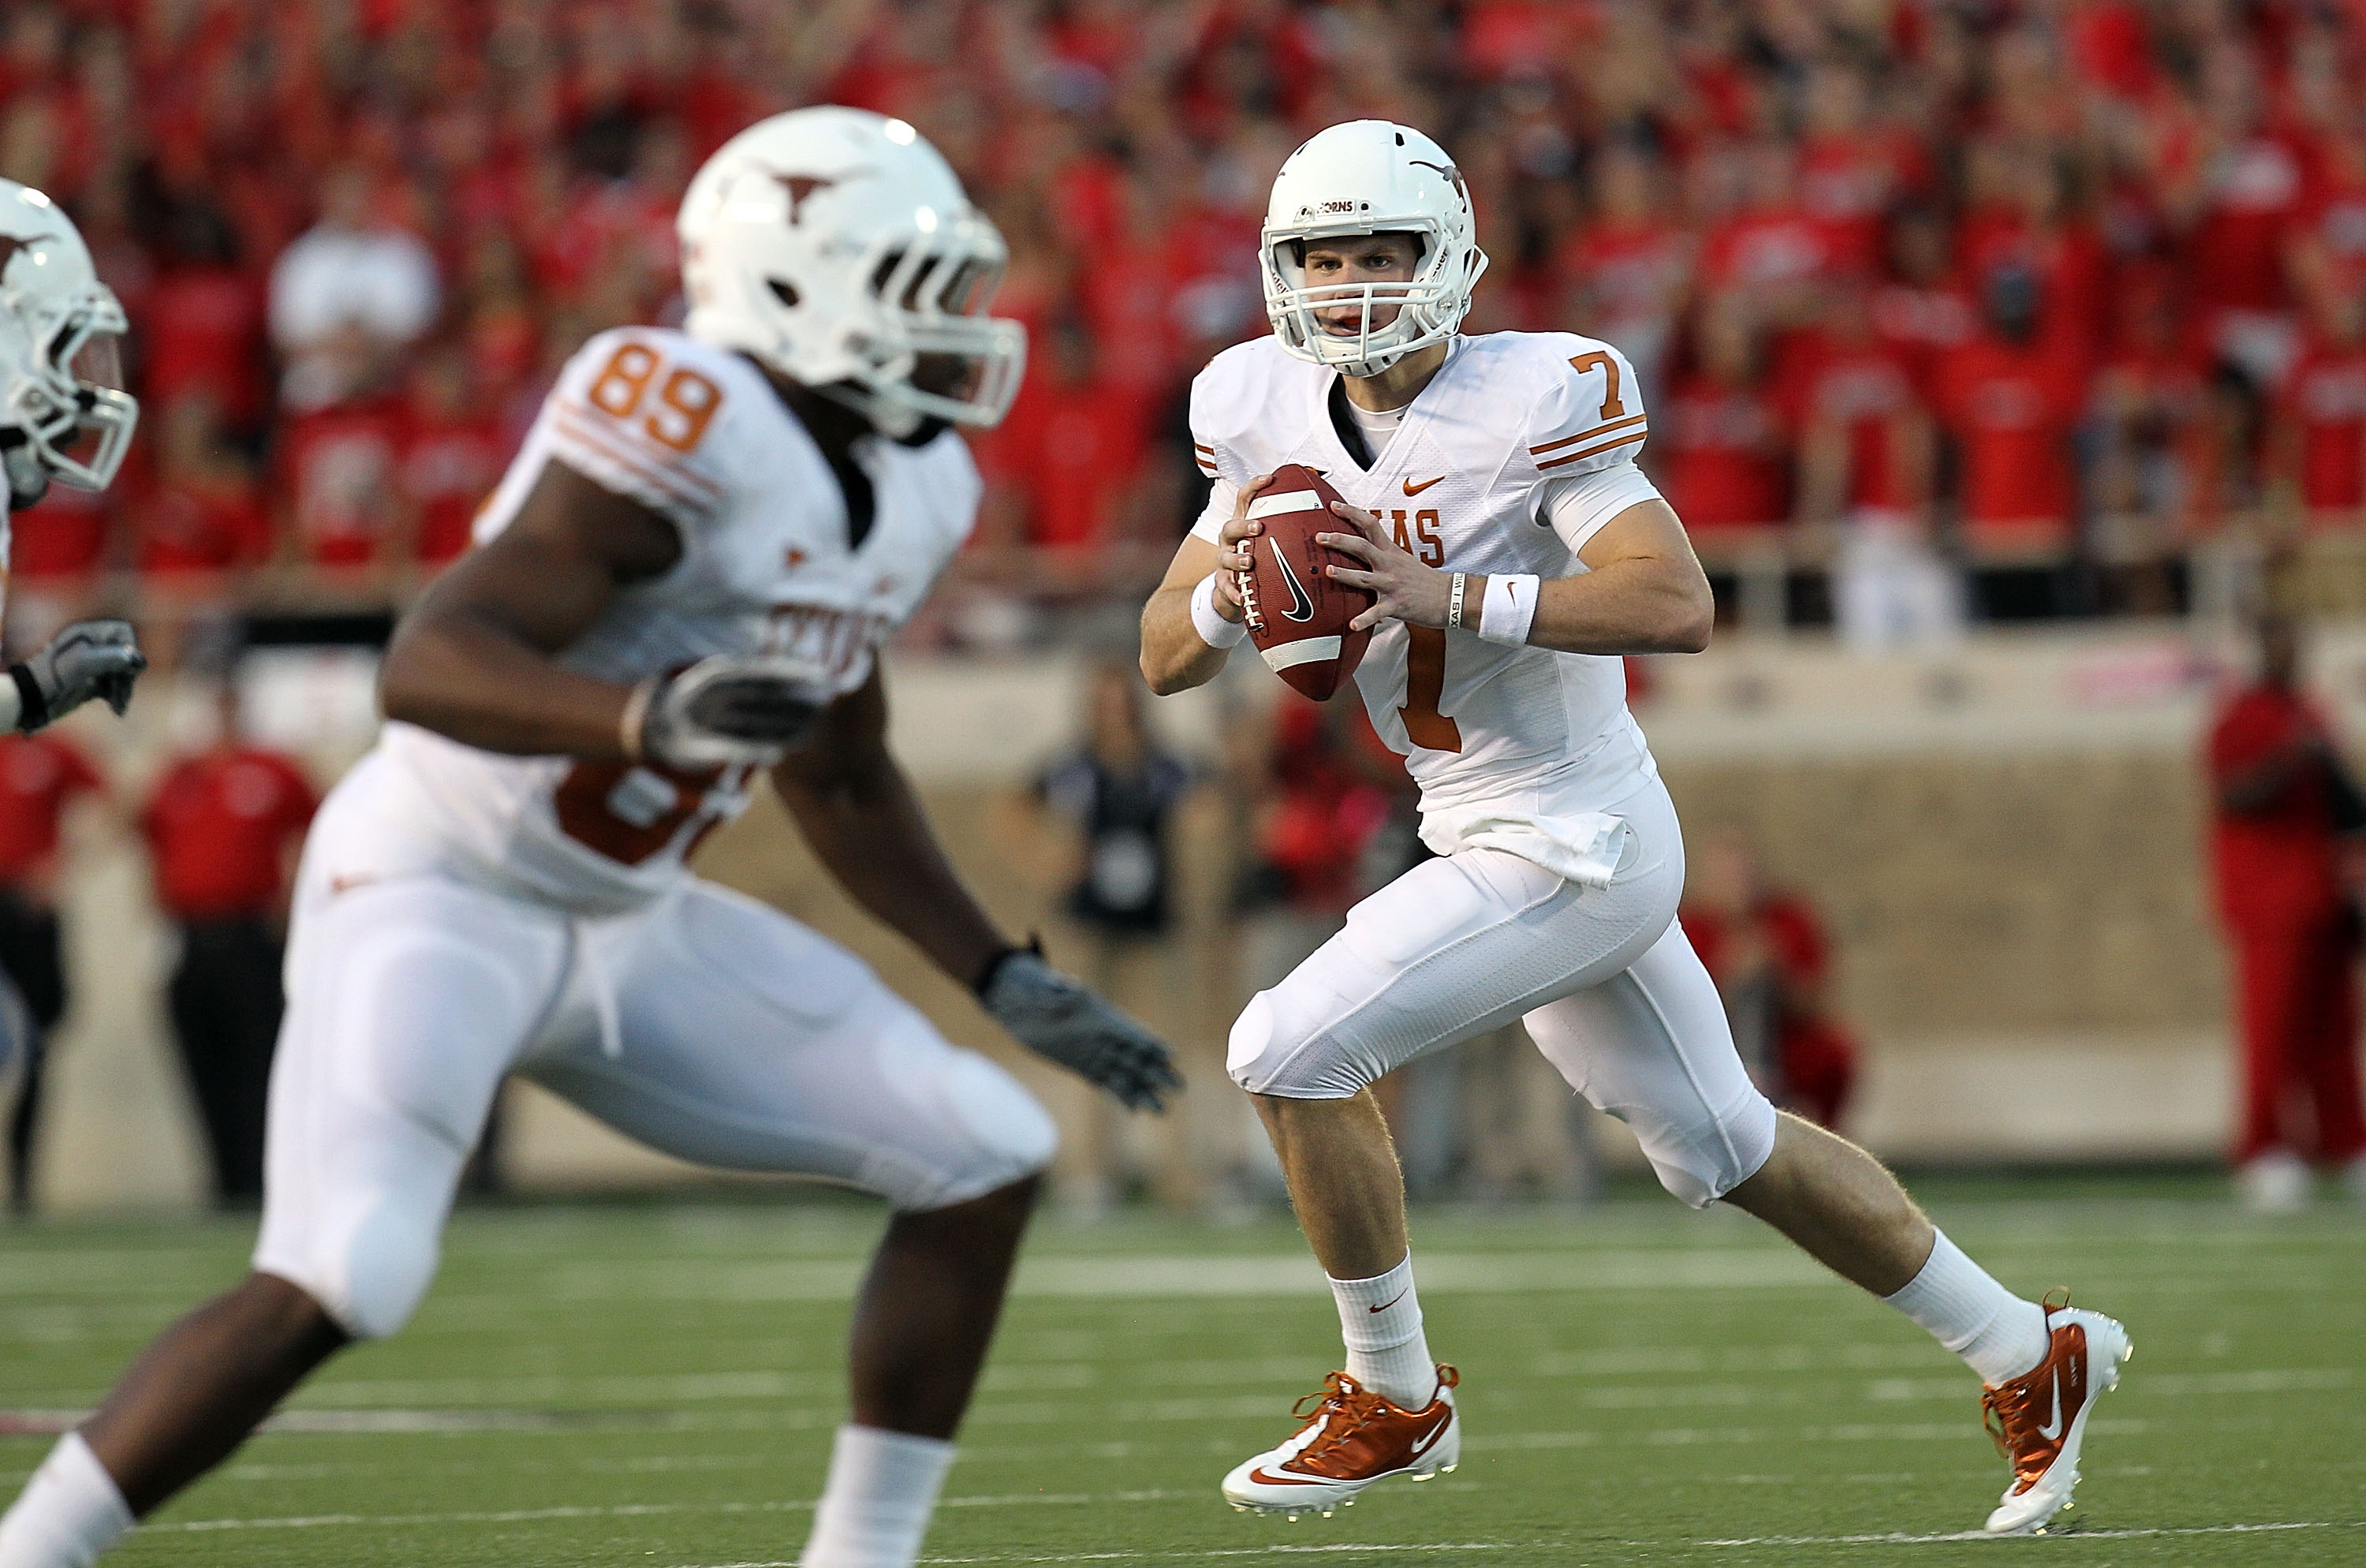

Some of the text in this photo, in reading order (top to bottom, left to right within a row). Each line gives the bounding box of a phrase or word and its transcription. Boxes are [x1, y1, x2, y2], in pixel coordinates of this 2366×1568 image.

[589, 343, 724, 452] 89
[1568, 350, 1625, 420] 7
[1369, 509, 1445, 569] AS
